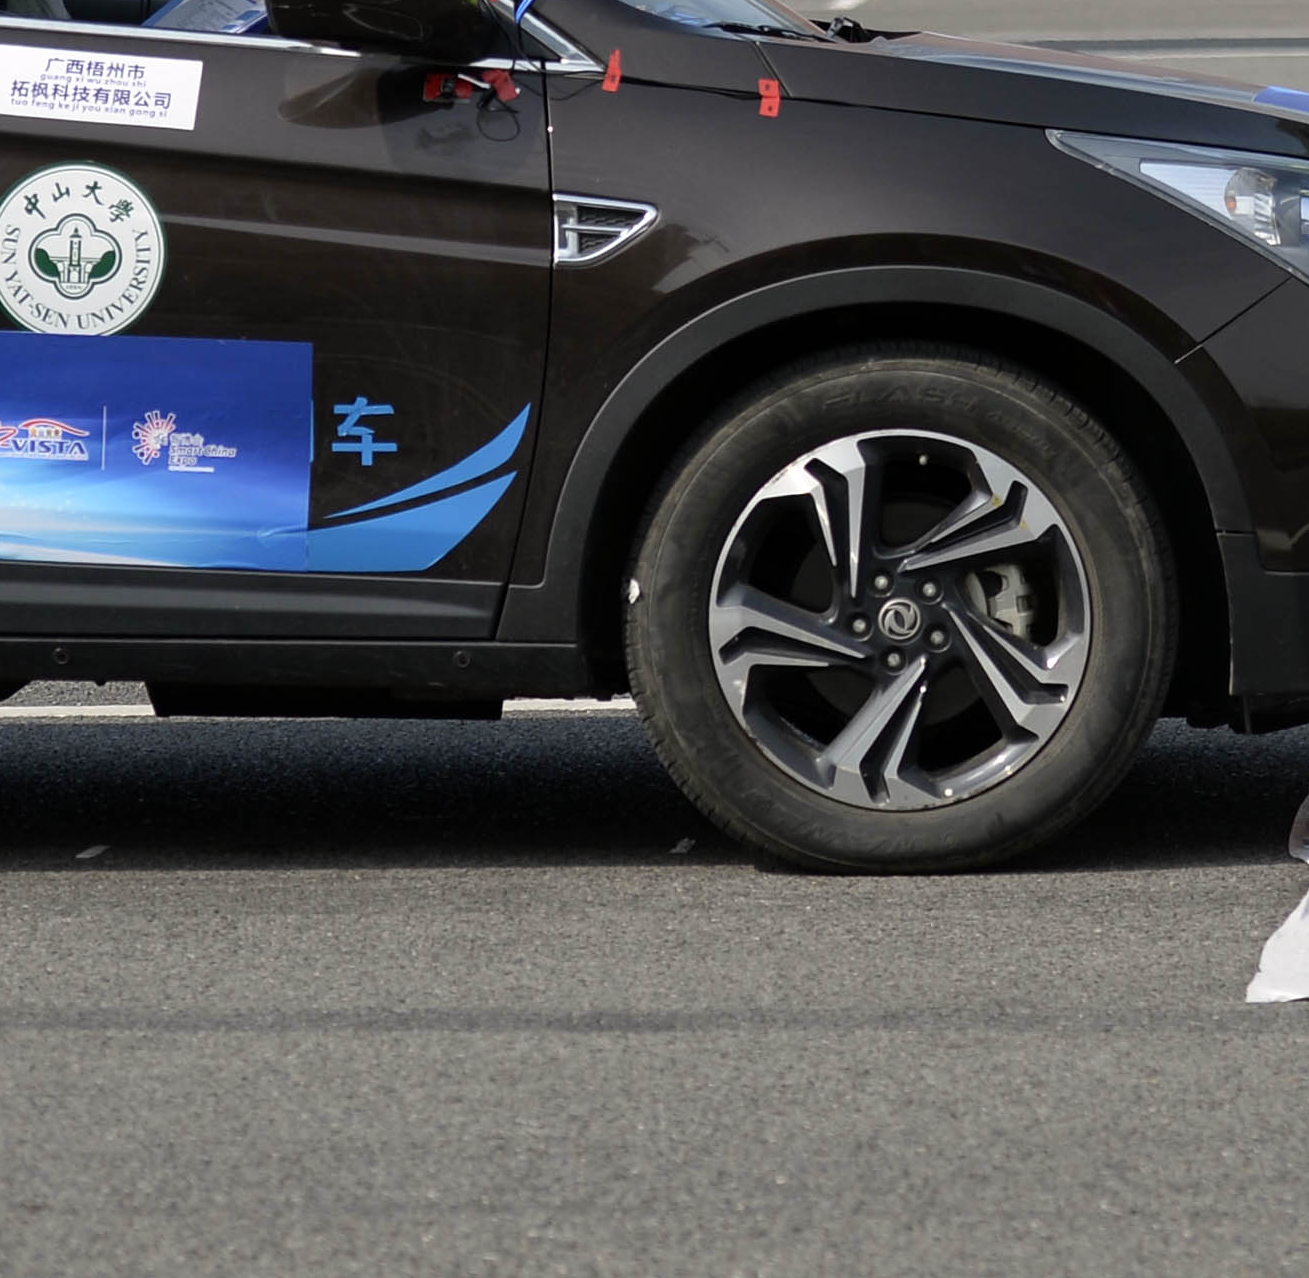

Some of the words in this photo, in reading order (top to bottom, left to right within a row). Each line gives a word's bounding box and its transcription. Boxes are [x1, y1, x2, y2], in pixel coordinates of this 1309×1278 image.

[40, 73, 72, 84] guang
[87, 78, 101, 86] wu
[104, 78, 128, 87] zhou
[132, 80, 147, 88] shi
[45, 57, 146, 80] 广西梧州市
[10, 79, 172, 110] 拓枫科技有限公司
[11, 98, 28, 106] tuo
[31, 99, 55, 110] feng
[58, 99, 69, 109] ke
[81, 104, 101, 113] you
[104, 105, 126, 114] xian
[1, 223, 21, 266] SUN
[76, 228, 152, 330] UNIVERSITY
[4, 269, 71, 329] YAT-SEN
[331, 396, 398, 467] 车
[170, 444, 203, 456] Smart
[204, 445, 236, 458] China
[170, 456, 197, 465] Expo
